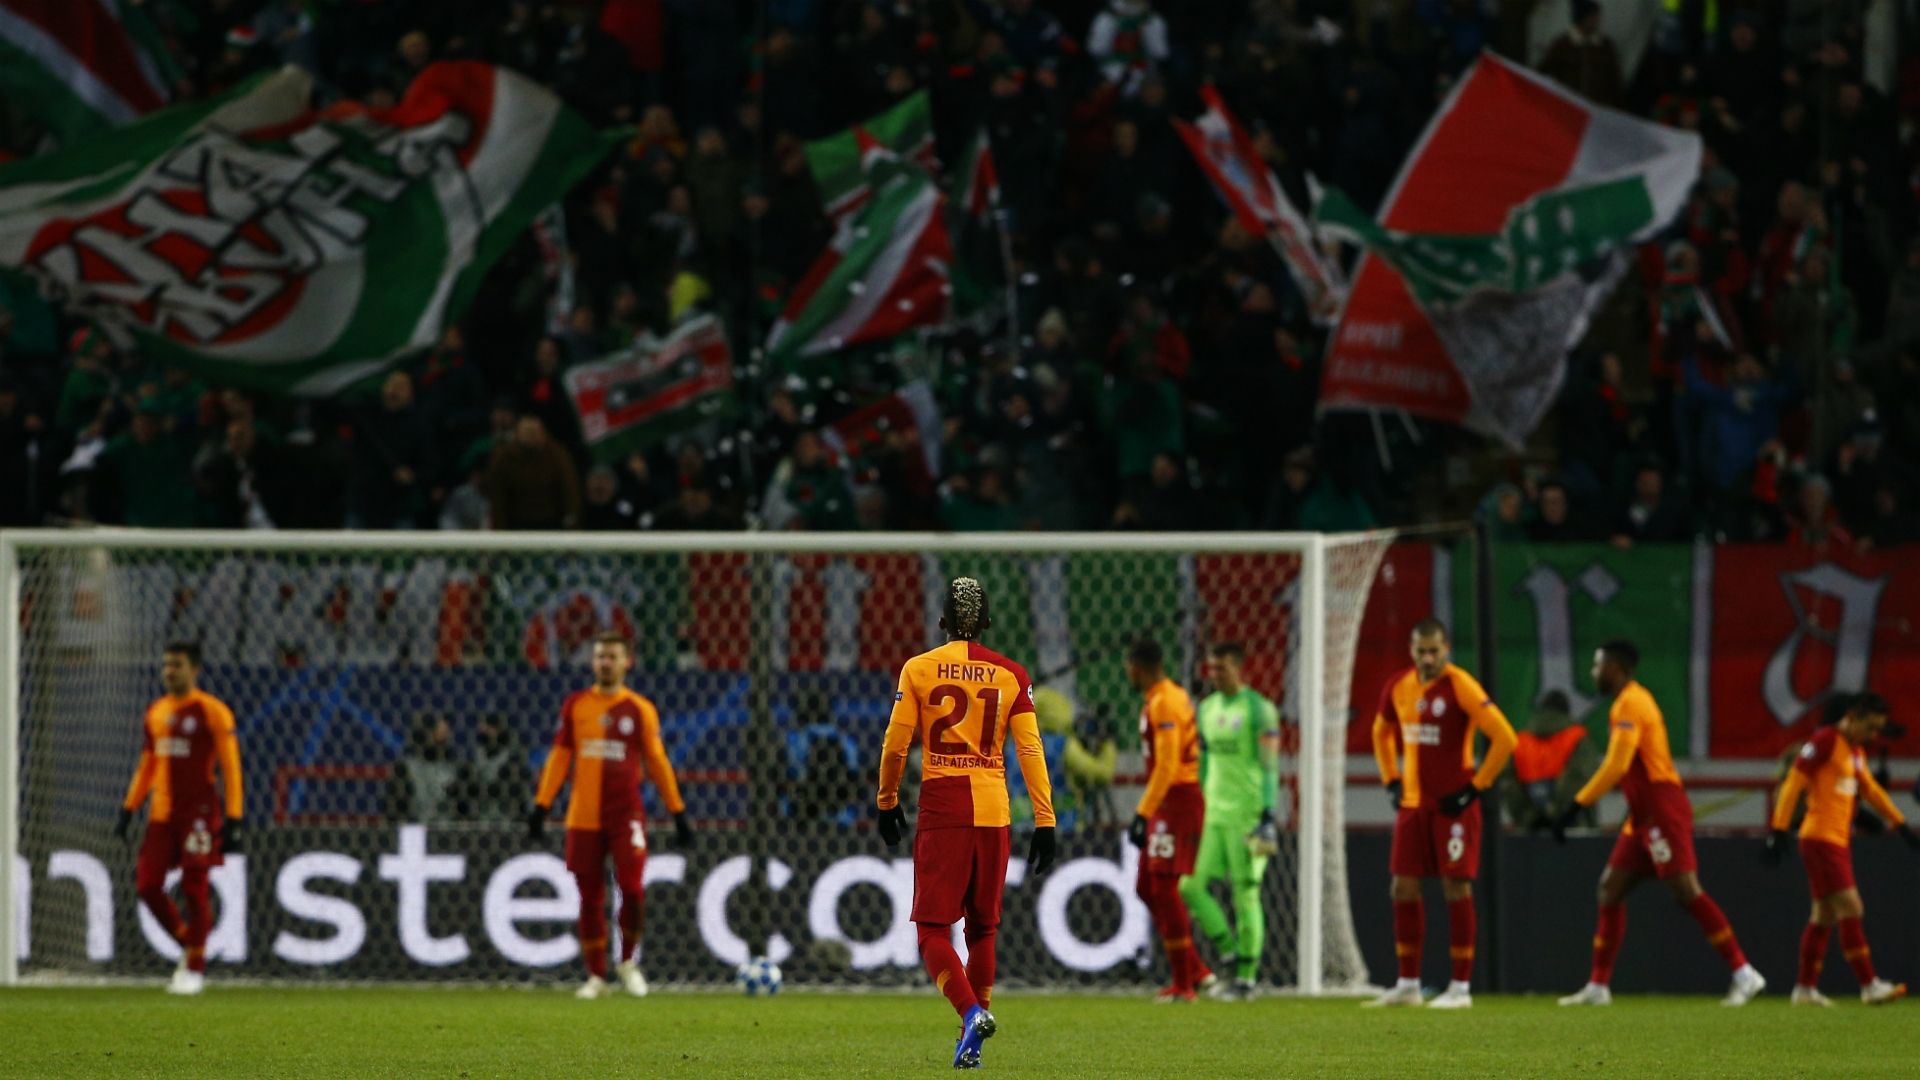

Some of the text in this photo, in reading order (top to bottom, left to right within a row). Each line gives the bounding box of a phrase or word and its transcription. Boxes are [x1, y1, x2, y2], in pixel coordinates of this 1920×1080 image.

[938, 664, 996, 683] HENRY
[929, 684, 999, 757] 21
[1447, 838, 1465, 862] 9
